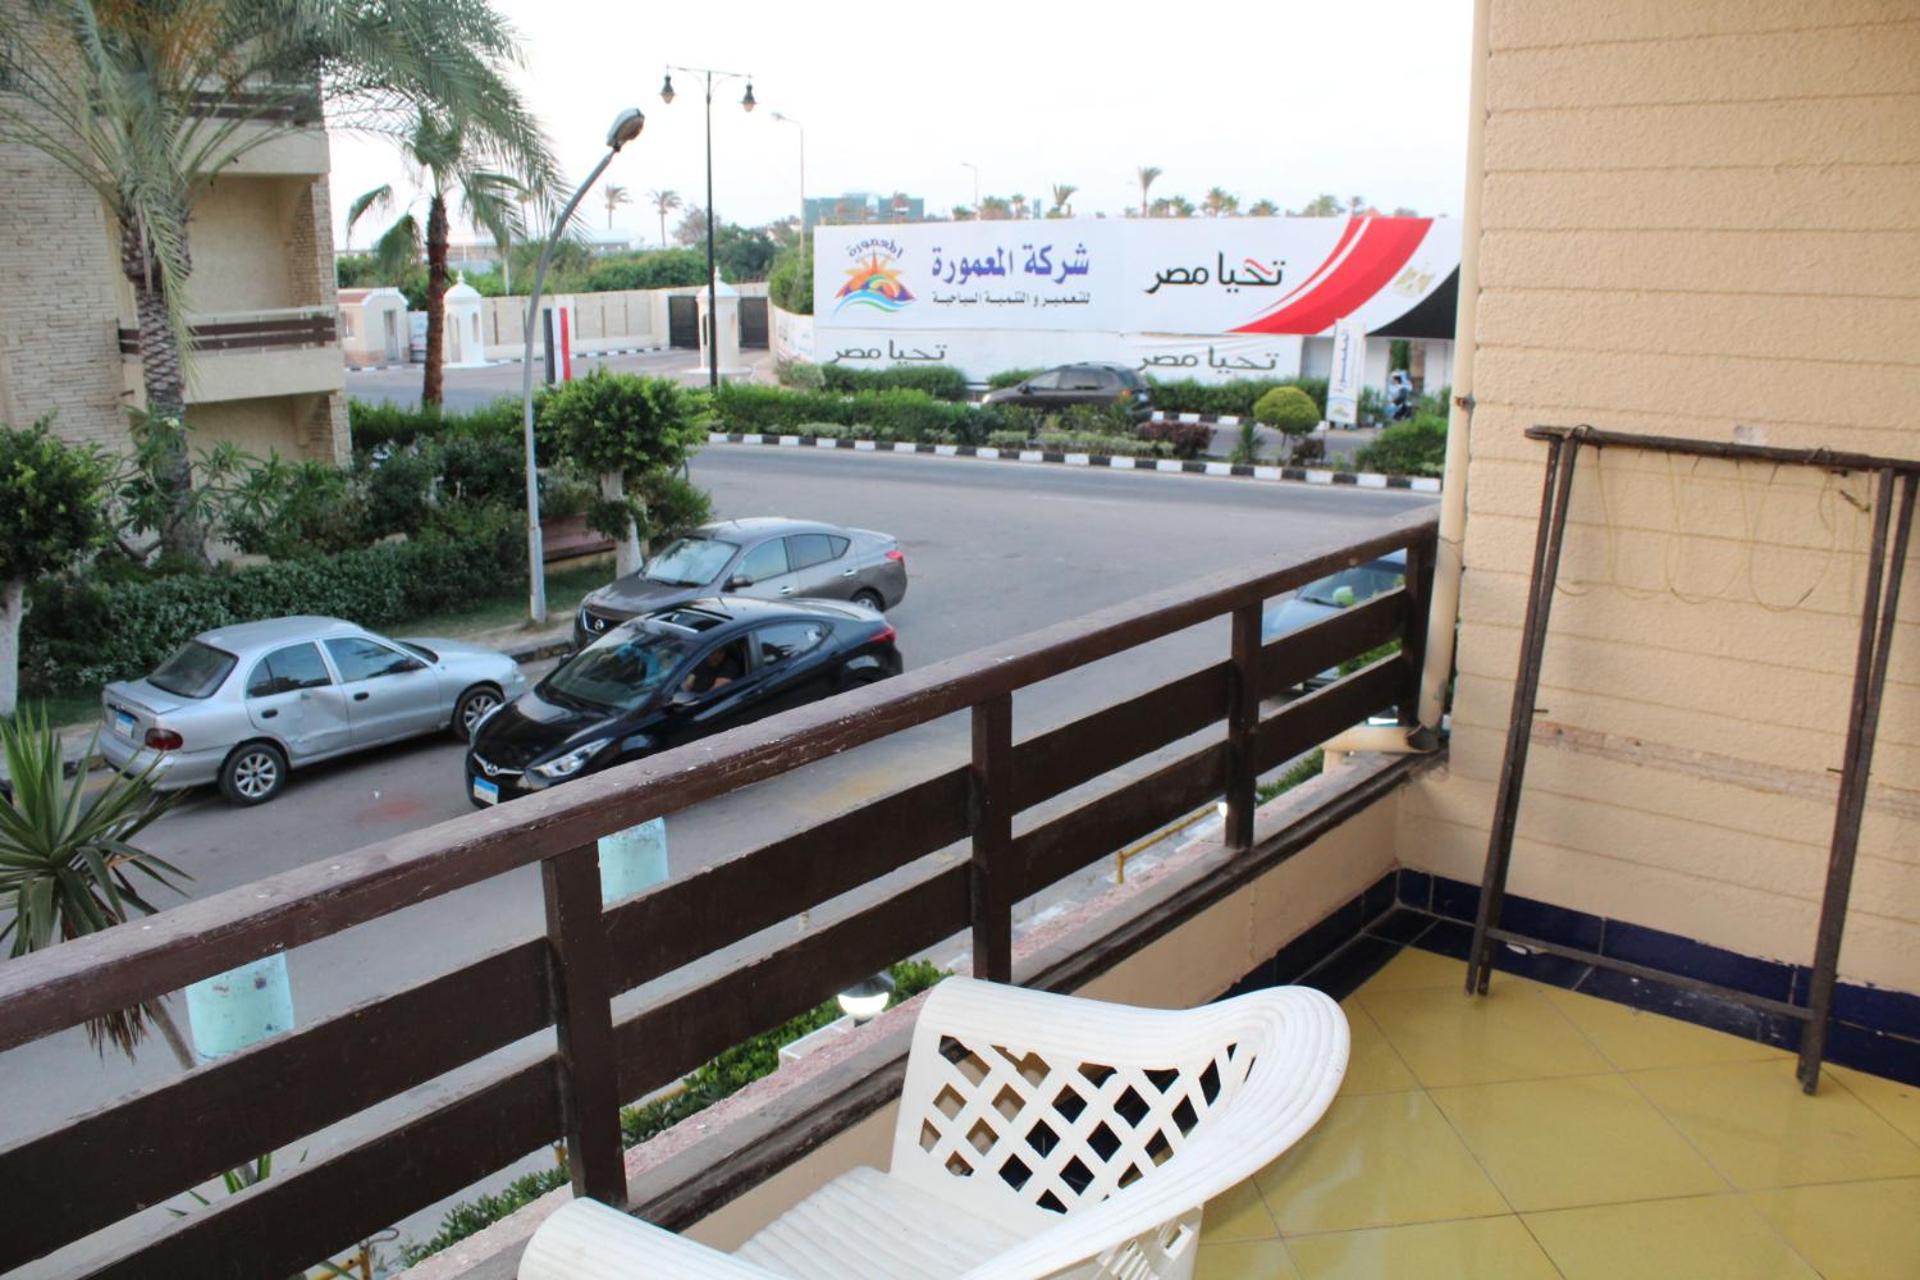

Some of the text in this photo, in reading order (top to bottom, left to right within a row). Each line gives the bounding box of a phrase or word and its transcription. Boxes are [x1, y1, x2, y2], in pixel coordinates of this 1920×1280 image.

[931, 243, 1090, 284] شركة المعمورة
[1145, 251, 1286, 294] تحيا مصر
[829, 339, 948, 365] تحيا مصر
[1136, 346, 1280, 374] تحيا مصر
